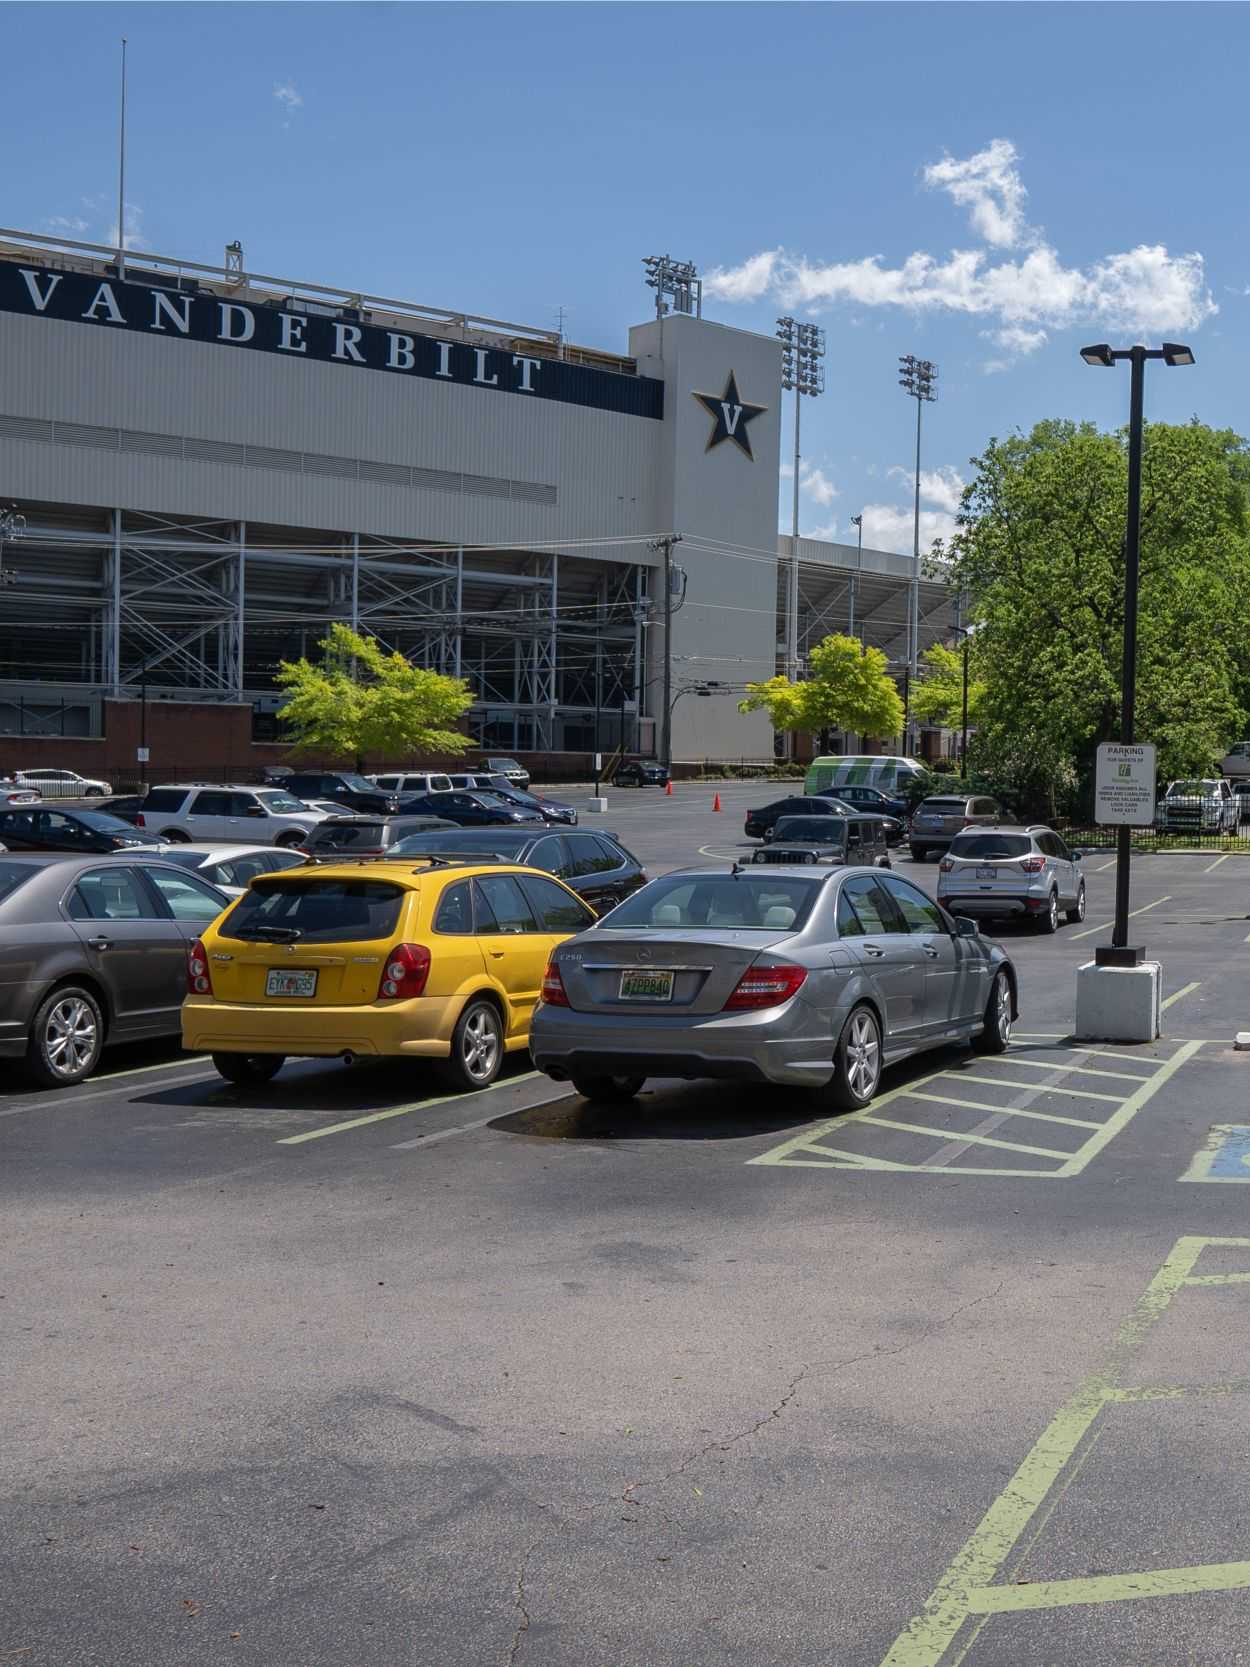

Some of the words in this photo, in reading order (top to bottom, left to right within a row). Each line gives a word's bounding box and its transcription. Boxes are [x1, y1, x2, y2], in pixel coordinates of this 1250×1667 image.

[18, 268, 542, 392] VANDERBILT
[721, 402, 743, 435] V
[1107, 747, 1144, 755] PARKING
